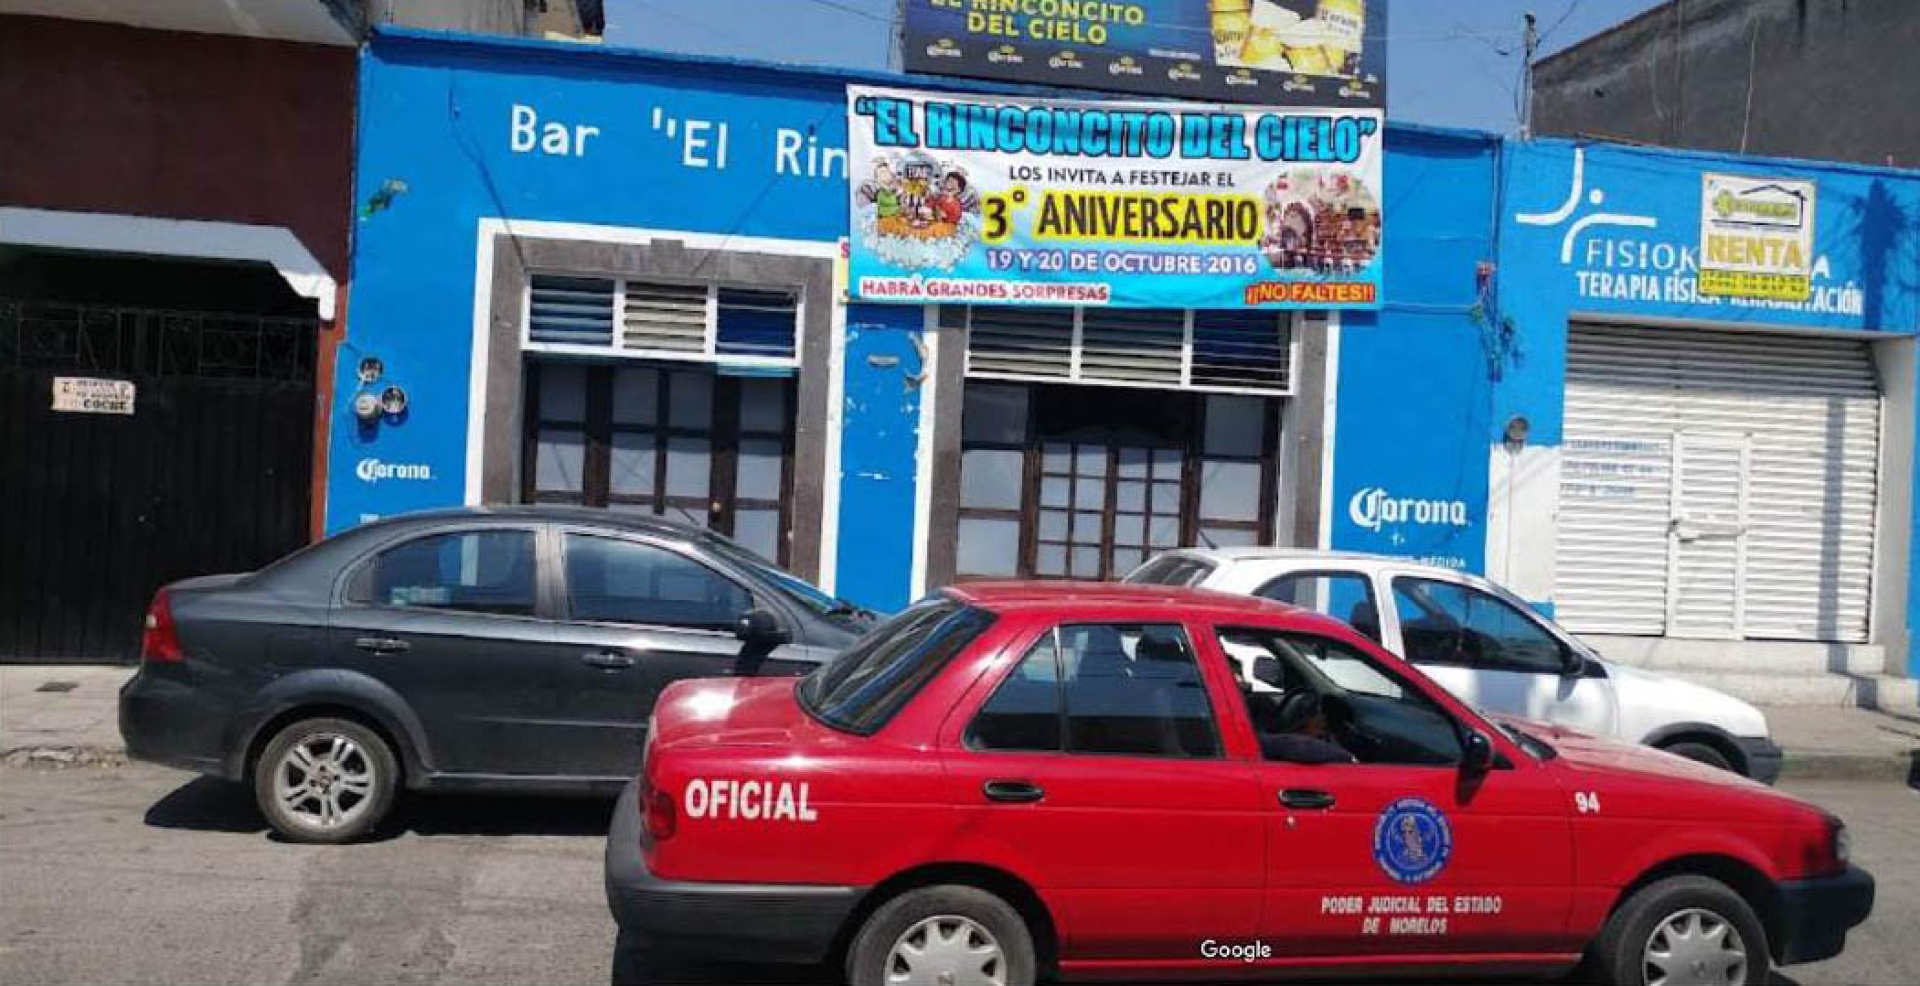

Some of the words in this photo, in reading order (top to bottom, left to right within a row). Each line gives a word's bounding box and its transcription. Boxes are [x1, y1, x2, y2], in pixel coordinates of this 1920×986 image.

[968, 11, 1020, 37] DEL
[1028, 18, 1107, 45] CIELO
[510, 103, 600, 157] Bar
[924, 100, 1176, 159] RINCONCITO
[1180, 110, 1250, 161] DEL
[1009, 165, 1042, 182] LOS
[1047, 166, 1107, 185] INVITA
[1110, 170, 1124, 186] A
[1129, 170, 1211, 188] FESTEJAR
[1217, 172, 1236, 188] EL
[1037, 193, 1258, 240] ANIVERSARIO
[987, 250, 1012, 270] 19
[1018, 251, 1035, 270] Y
[1038, 251, 1063, 271] 20
[1071, 252, 1098, 271] DE
[1104, 254, 1201, 273] OCTUBRE
[1207, 255, 1258, 274] 2016
[1706, 233, 1803, 269] RENTA
[926, 281, 1007, 298] GRANDES
[1013, 283, 1108, 301] SORPRESAS
[1294, 283, 1375, 303] FALTES!!
[1575, 270, 1660, 301] TERAPIA
[356, 458, 432, 484] Corona
[1348, 486, 1467, 533] Corona
[684, 778, 818, 821] OFICIAL
[1574, 790, 1601, 814] 94
[1321, 895, 1363, 915] PODER
[1367, 895, 1422, 915] JUDICIAL
[1426, 895, 1449, 914] DEL
[1453, 895, 1503, 915] ESTADO
[1361, 917, 1381, 935] DE
[1388, 917, 1449, 935] MORELOS
